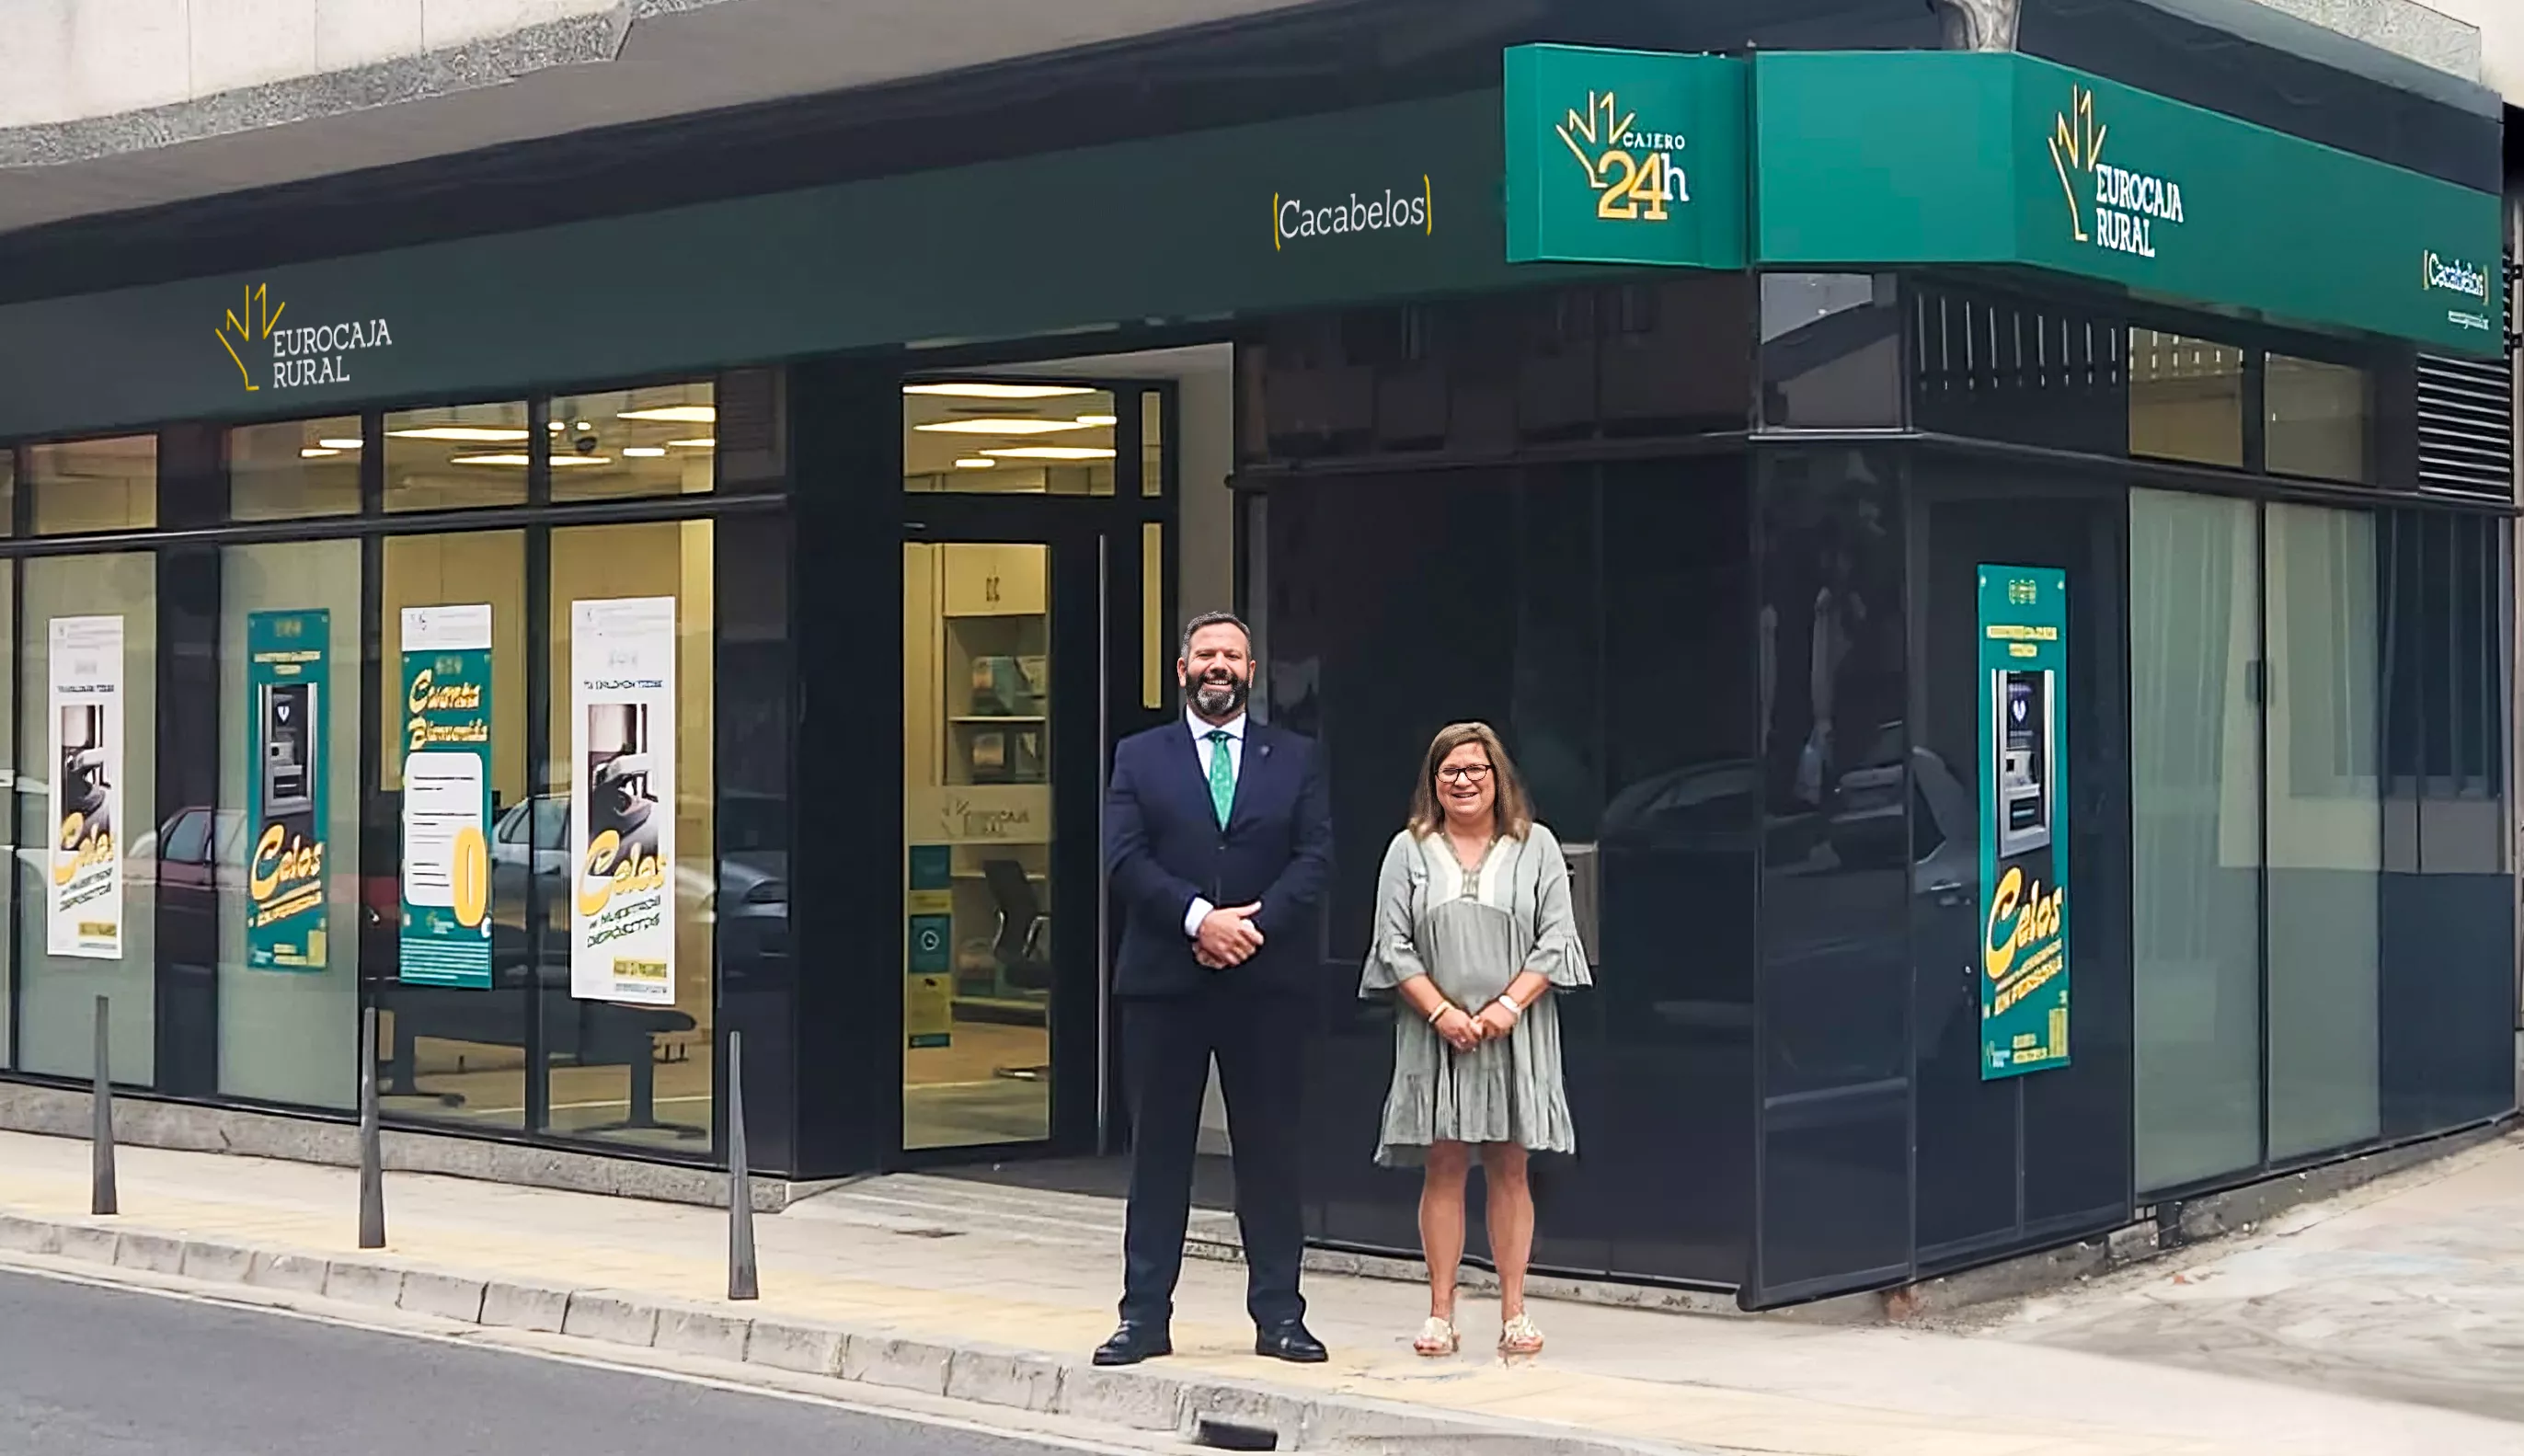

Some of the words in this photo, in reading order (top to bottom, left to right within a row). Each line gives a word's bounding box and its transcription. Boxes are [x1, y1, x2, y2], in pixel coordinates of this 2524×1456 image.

[1623, 132, 1685, 150] CAJERO
[1598, 150, 1690, 220] 24h
[2095, 163, 2184, 223] EUROCAJA
[2096, 207, 2155, 258] RURAL
[273, 318, 393, 358] EUROCAJA
[273, 355, 350, 388] RURAL
